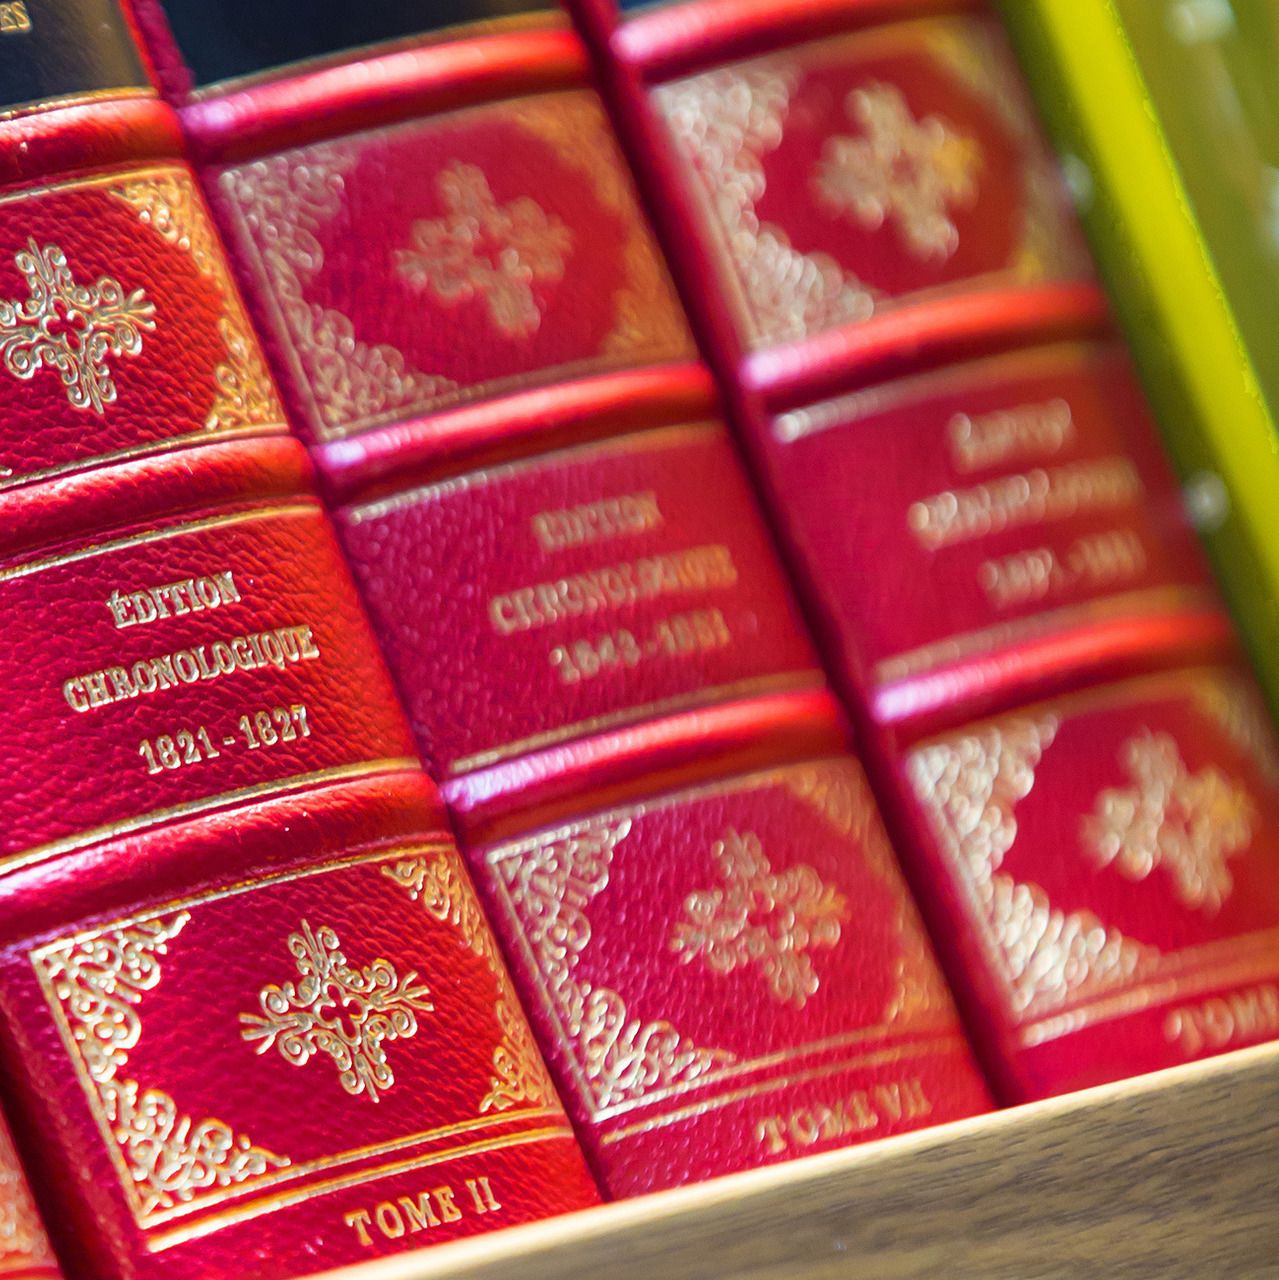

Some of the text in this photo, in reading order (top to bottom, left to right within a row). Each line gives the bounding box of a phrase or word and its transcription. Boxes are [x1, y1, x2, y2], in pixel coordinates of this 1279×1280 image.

[106, 571, 241, 629] ÉDITION
[62, 624, 320, 713] CHRONOLOGIQUE
[344, 1176, 503, 1247] TOME II
